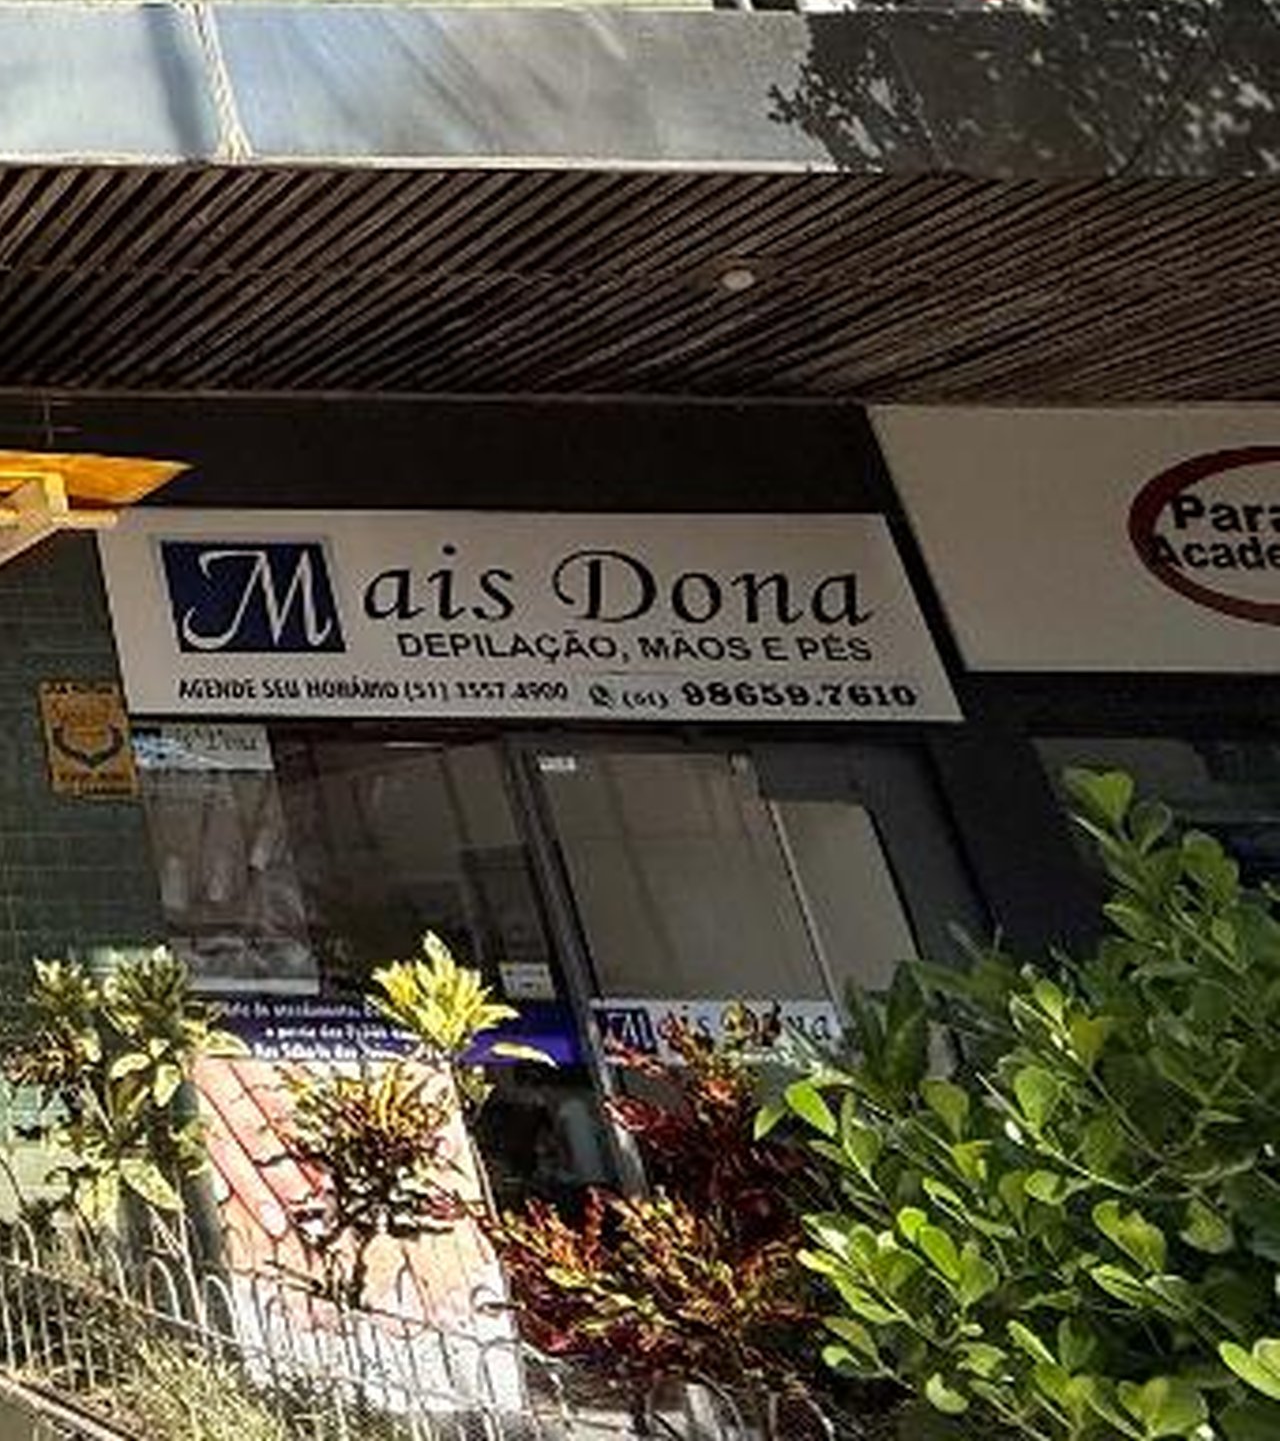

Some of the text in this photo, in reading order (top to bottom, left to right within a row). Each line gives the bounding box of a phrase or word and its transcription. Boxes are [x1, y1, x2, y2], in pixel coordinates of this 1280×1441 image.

[551, 549, 874, 626] Dona
[397, 629, 872, 664] DEPILAÇÃO, MÃOS E PÉS
[178, 677, 257, 699] AGENDE
[261, 678, 301, 699] SEU
